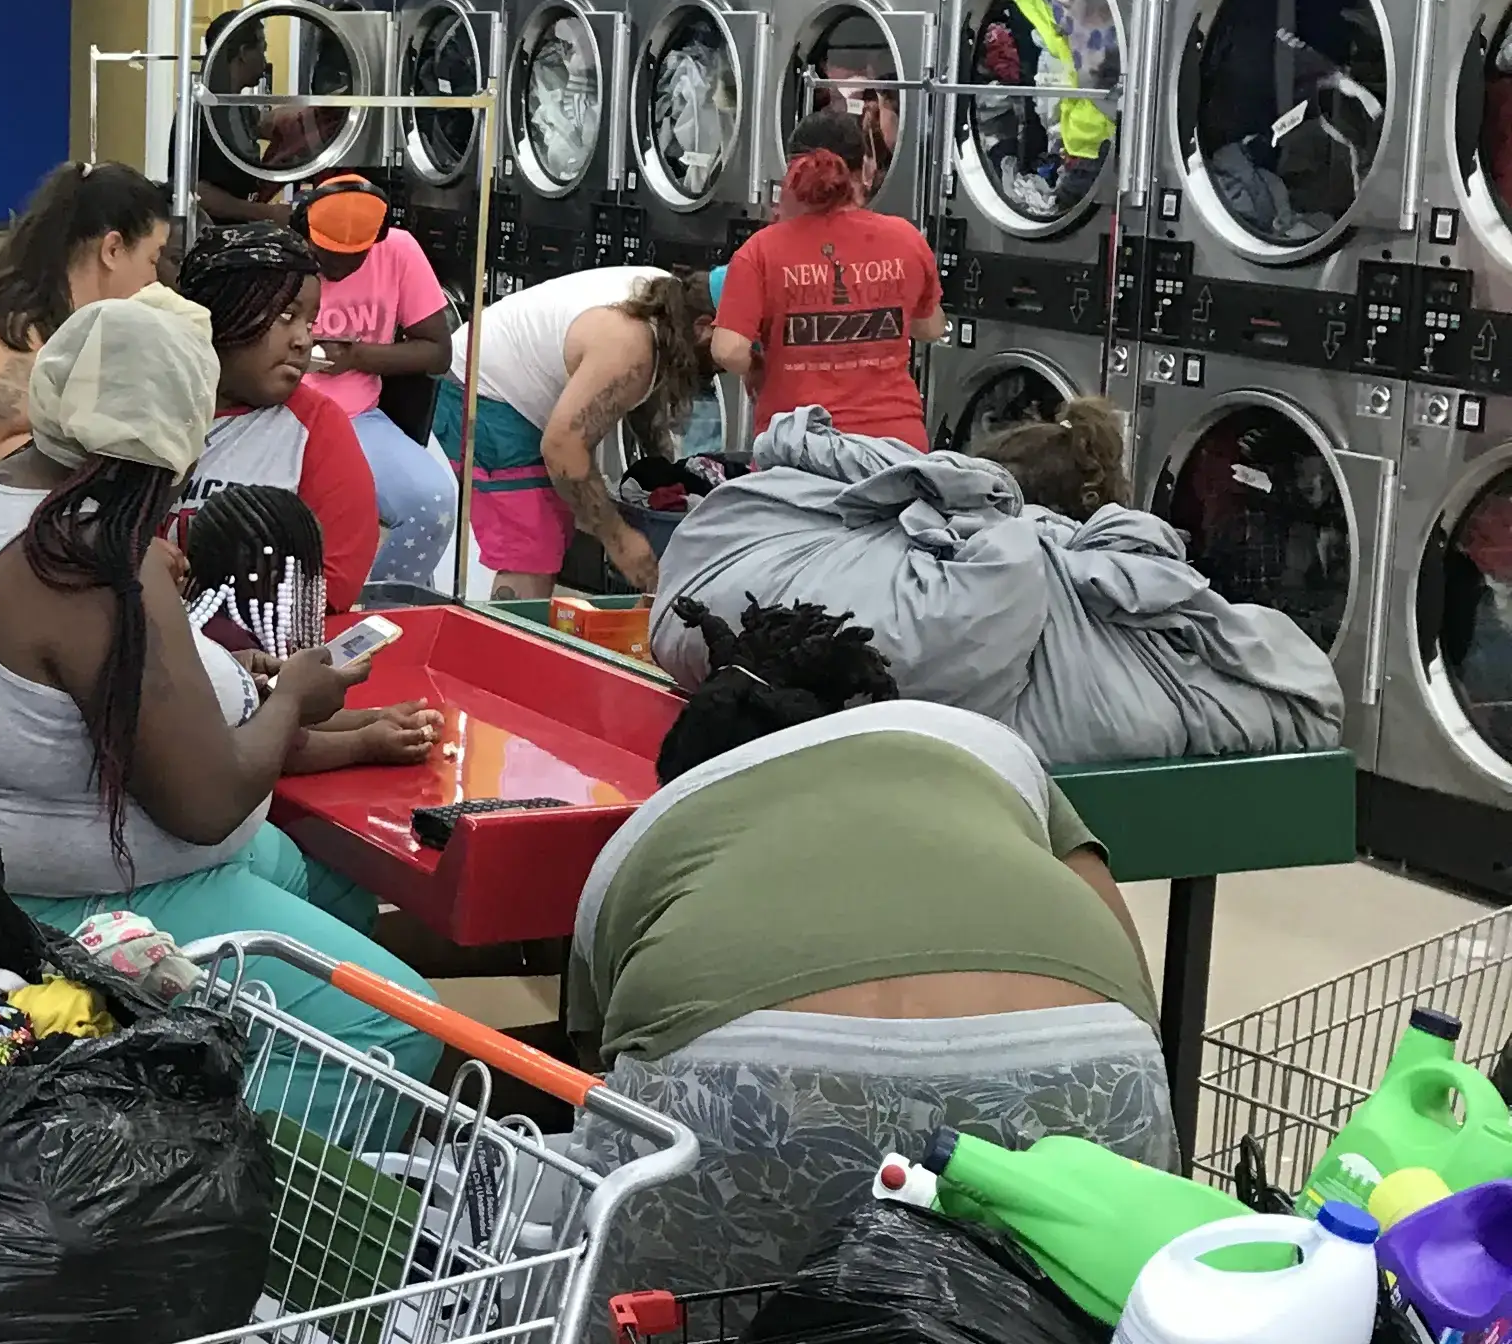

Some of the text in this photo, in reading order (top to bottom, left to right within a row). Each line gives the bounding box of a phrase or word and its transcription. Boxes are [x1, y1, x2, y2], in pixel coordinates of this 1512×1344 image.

[783, 258, 906, 288] NEW YORK
[787, 311, 901, 344] PIZZA
